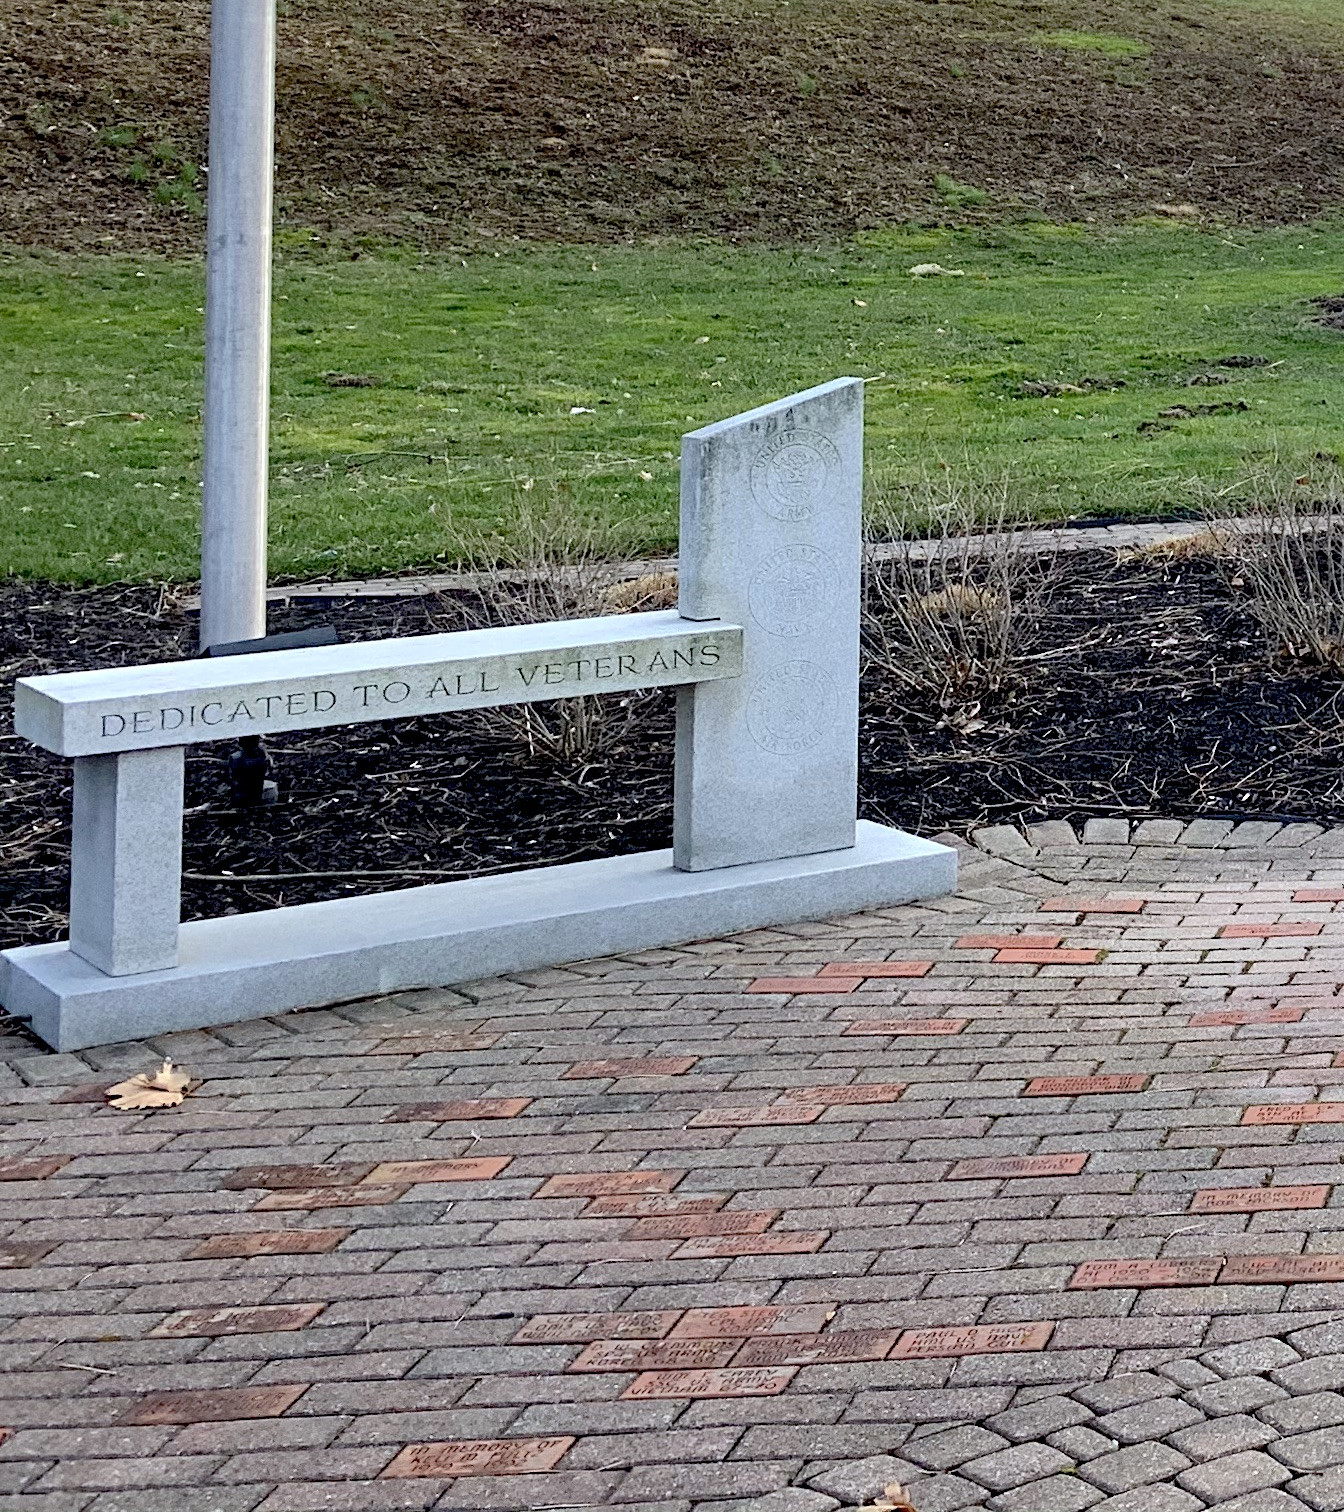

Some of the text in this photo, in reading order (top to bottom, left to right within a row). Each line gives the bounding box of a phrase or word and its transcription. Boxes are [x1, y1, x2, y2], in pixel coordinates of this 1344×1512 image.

[100, 643, 722, 738] DEDICATED TO ALL VETERANS
